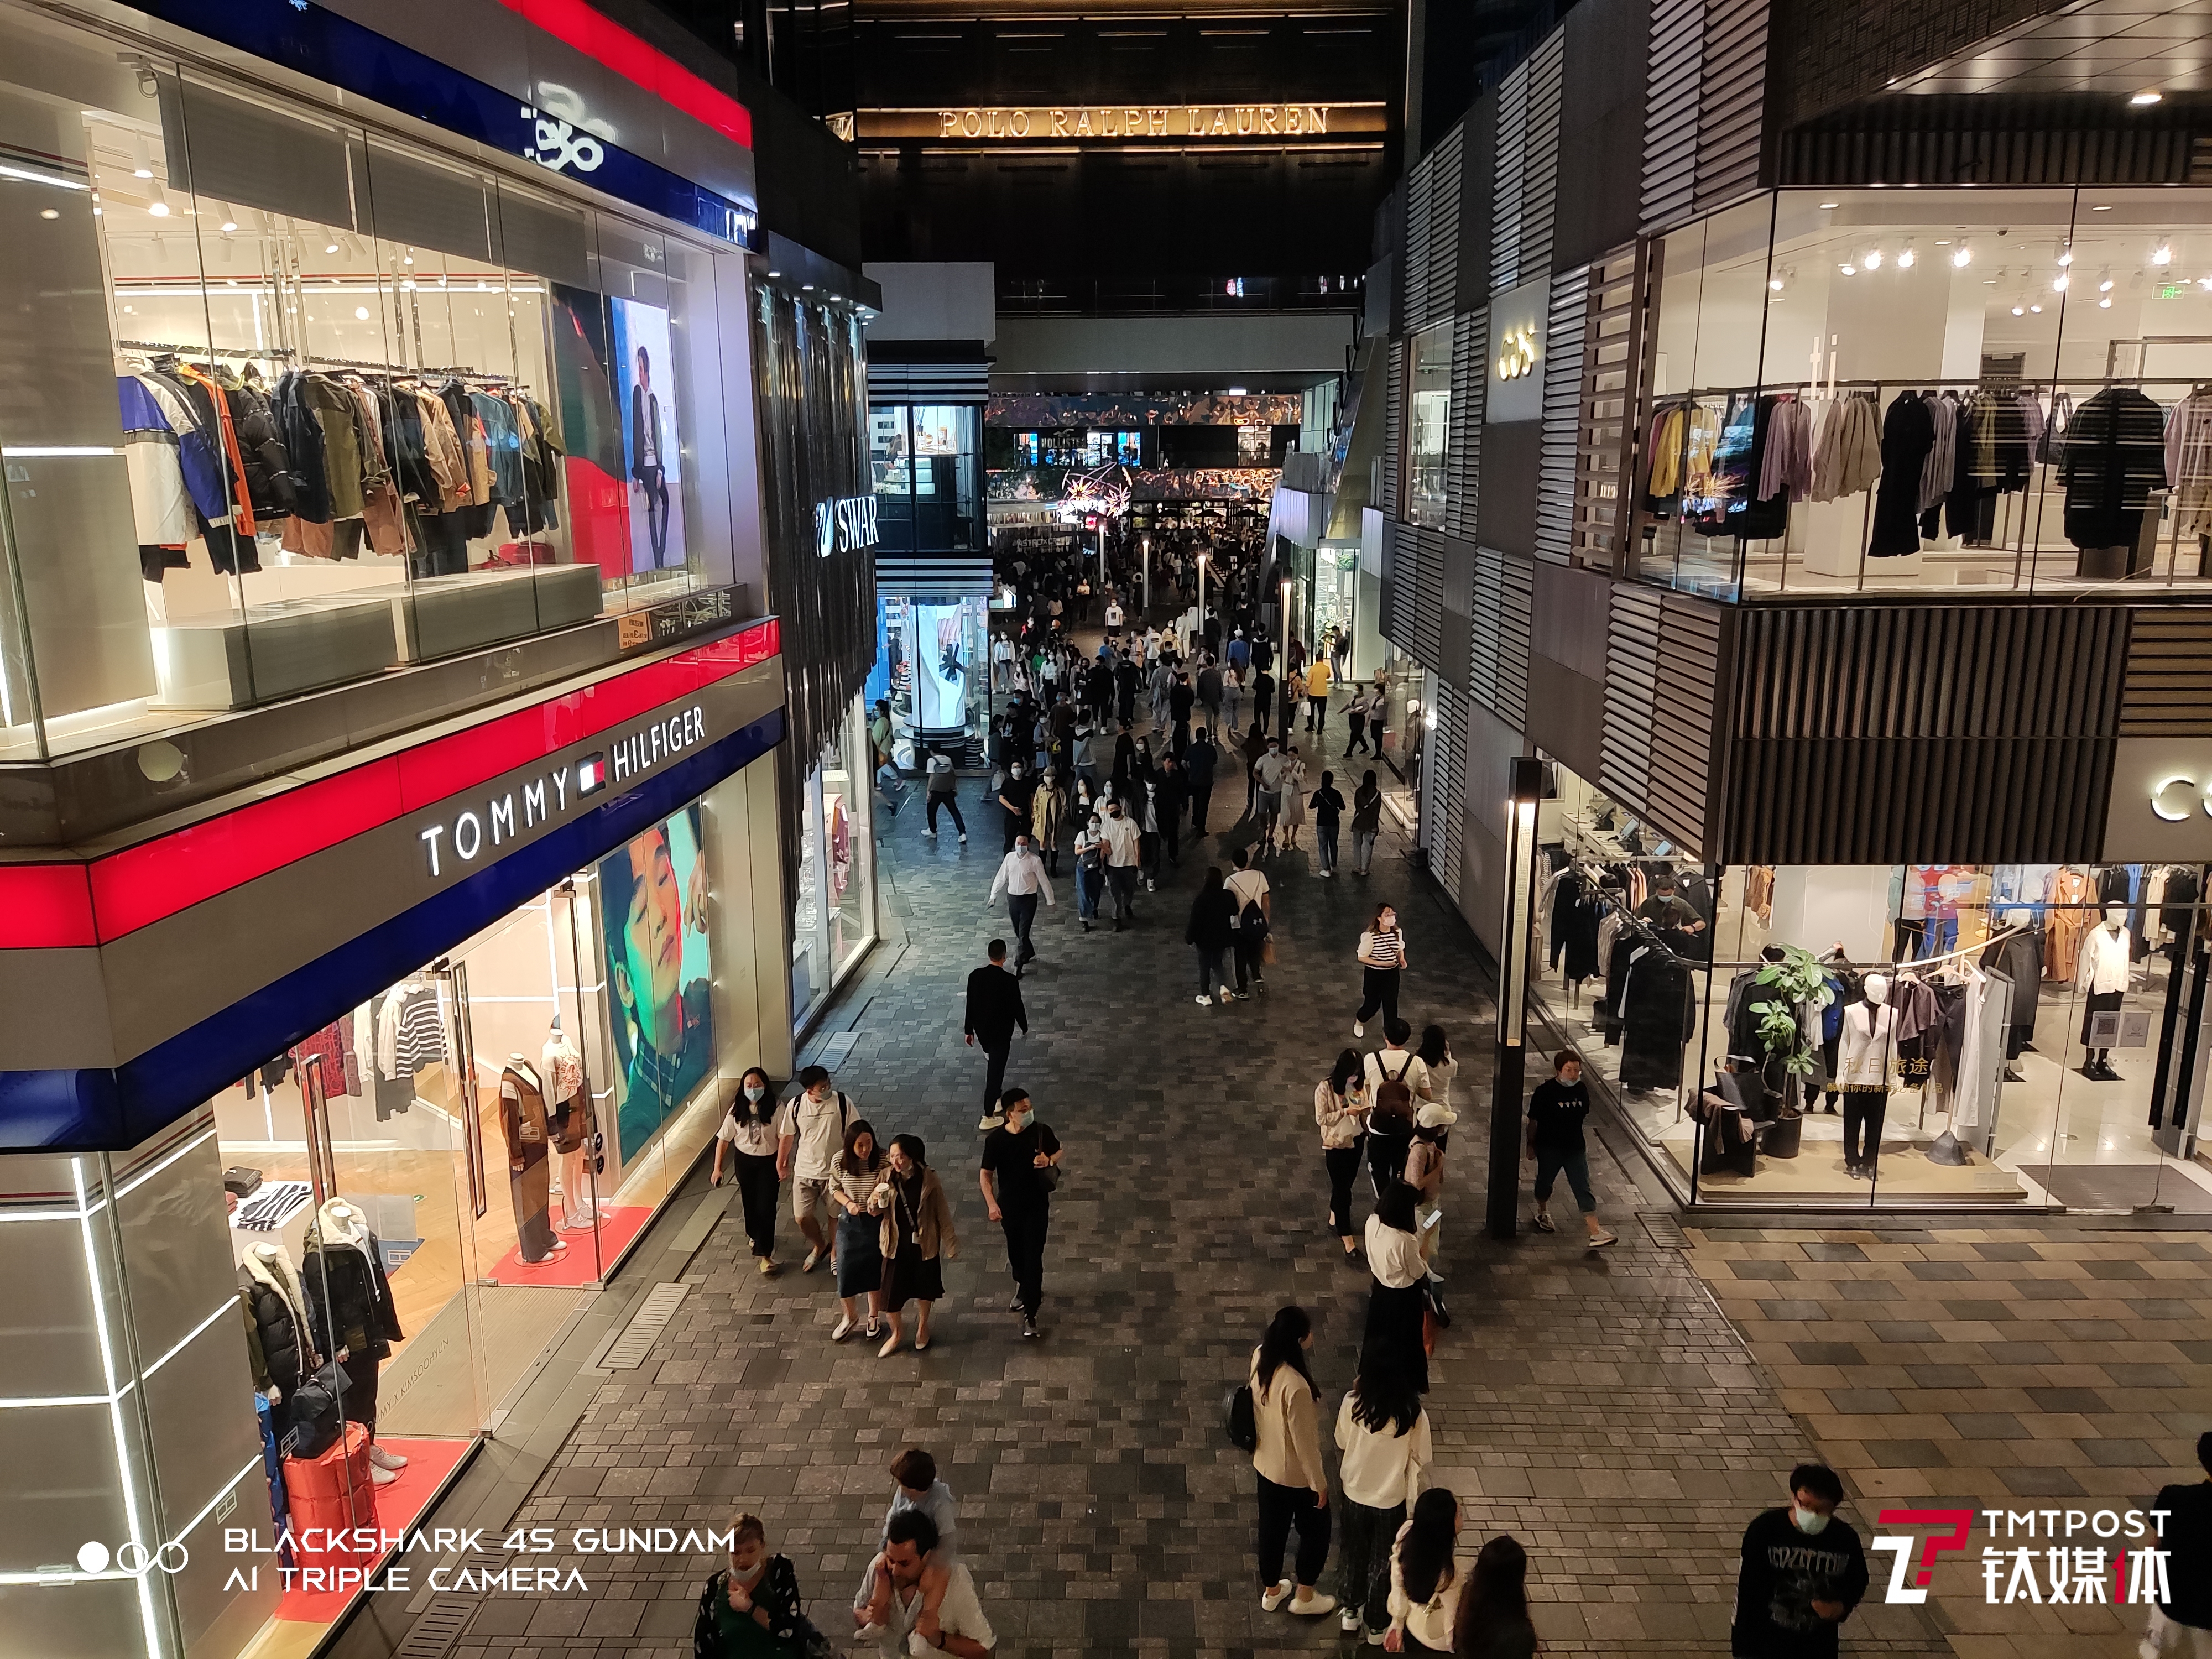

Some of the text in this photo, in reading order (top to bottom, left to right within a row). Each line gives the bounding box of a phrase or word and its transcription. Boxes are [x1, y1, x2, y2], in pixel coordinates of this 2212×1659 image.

[938, 107, 1330, 138] POLO RALPH LAUREN
[834, 495, 879, 554] SWAR
[420, 706, 706, 877] TOMMY HILFIGER
[1844, 1057, 1929, 1075] 秋日旅途
